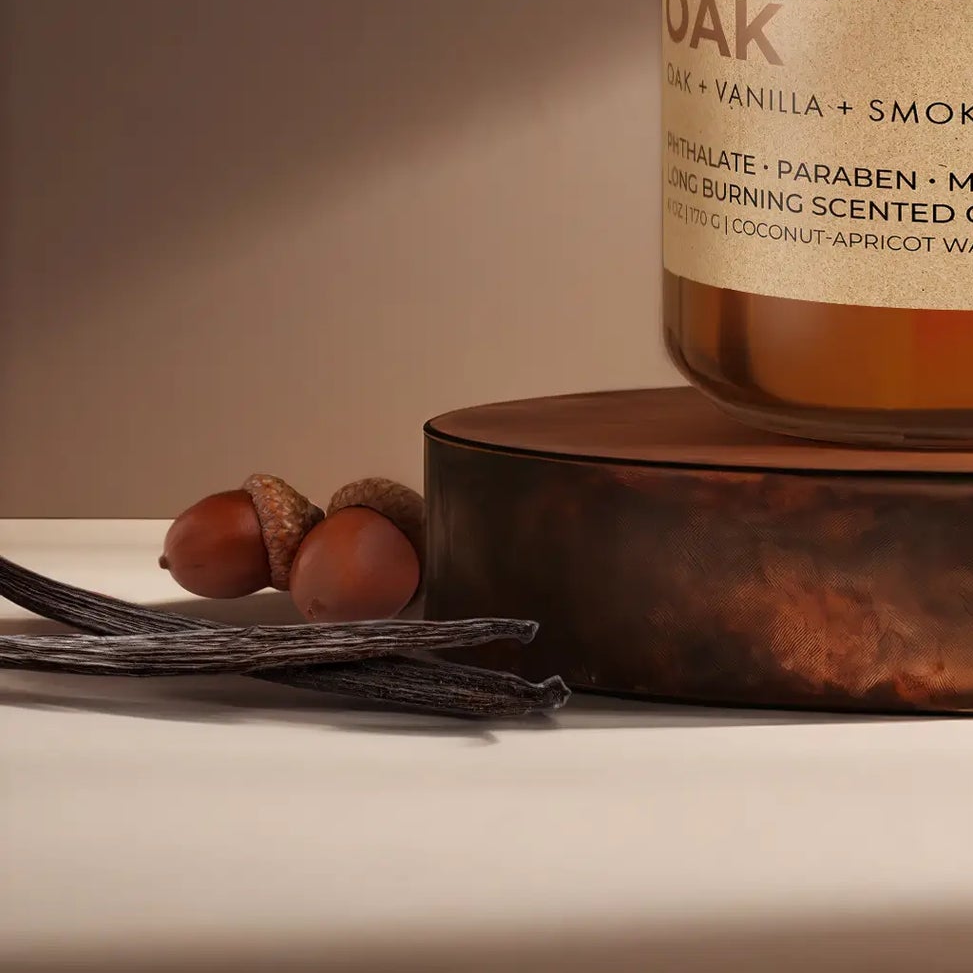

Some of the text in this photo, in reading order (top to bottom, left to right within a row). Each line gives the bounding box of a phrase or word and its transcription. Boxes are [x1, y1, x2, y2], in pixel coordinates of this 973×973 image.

[667, 62, 692, 94] OAK
[715, 78, 824, 118] VANILLA
[667, 130, 756, 175] PHTHALATE
[777, 159, 917, 191] PARABEN
[667, 162, 699, 195] LONG
[702, 177, 803, 214] BURNING
[811, 195, 956, 224] SCENTED
[672, 200, 683, 219] OZ
[690, 207, 708, 227] 170
[711, 213, 721, 230] G
[732, 217, 936, 253] COCONUT-APRICOT
